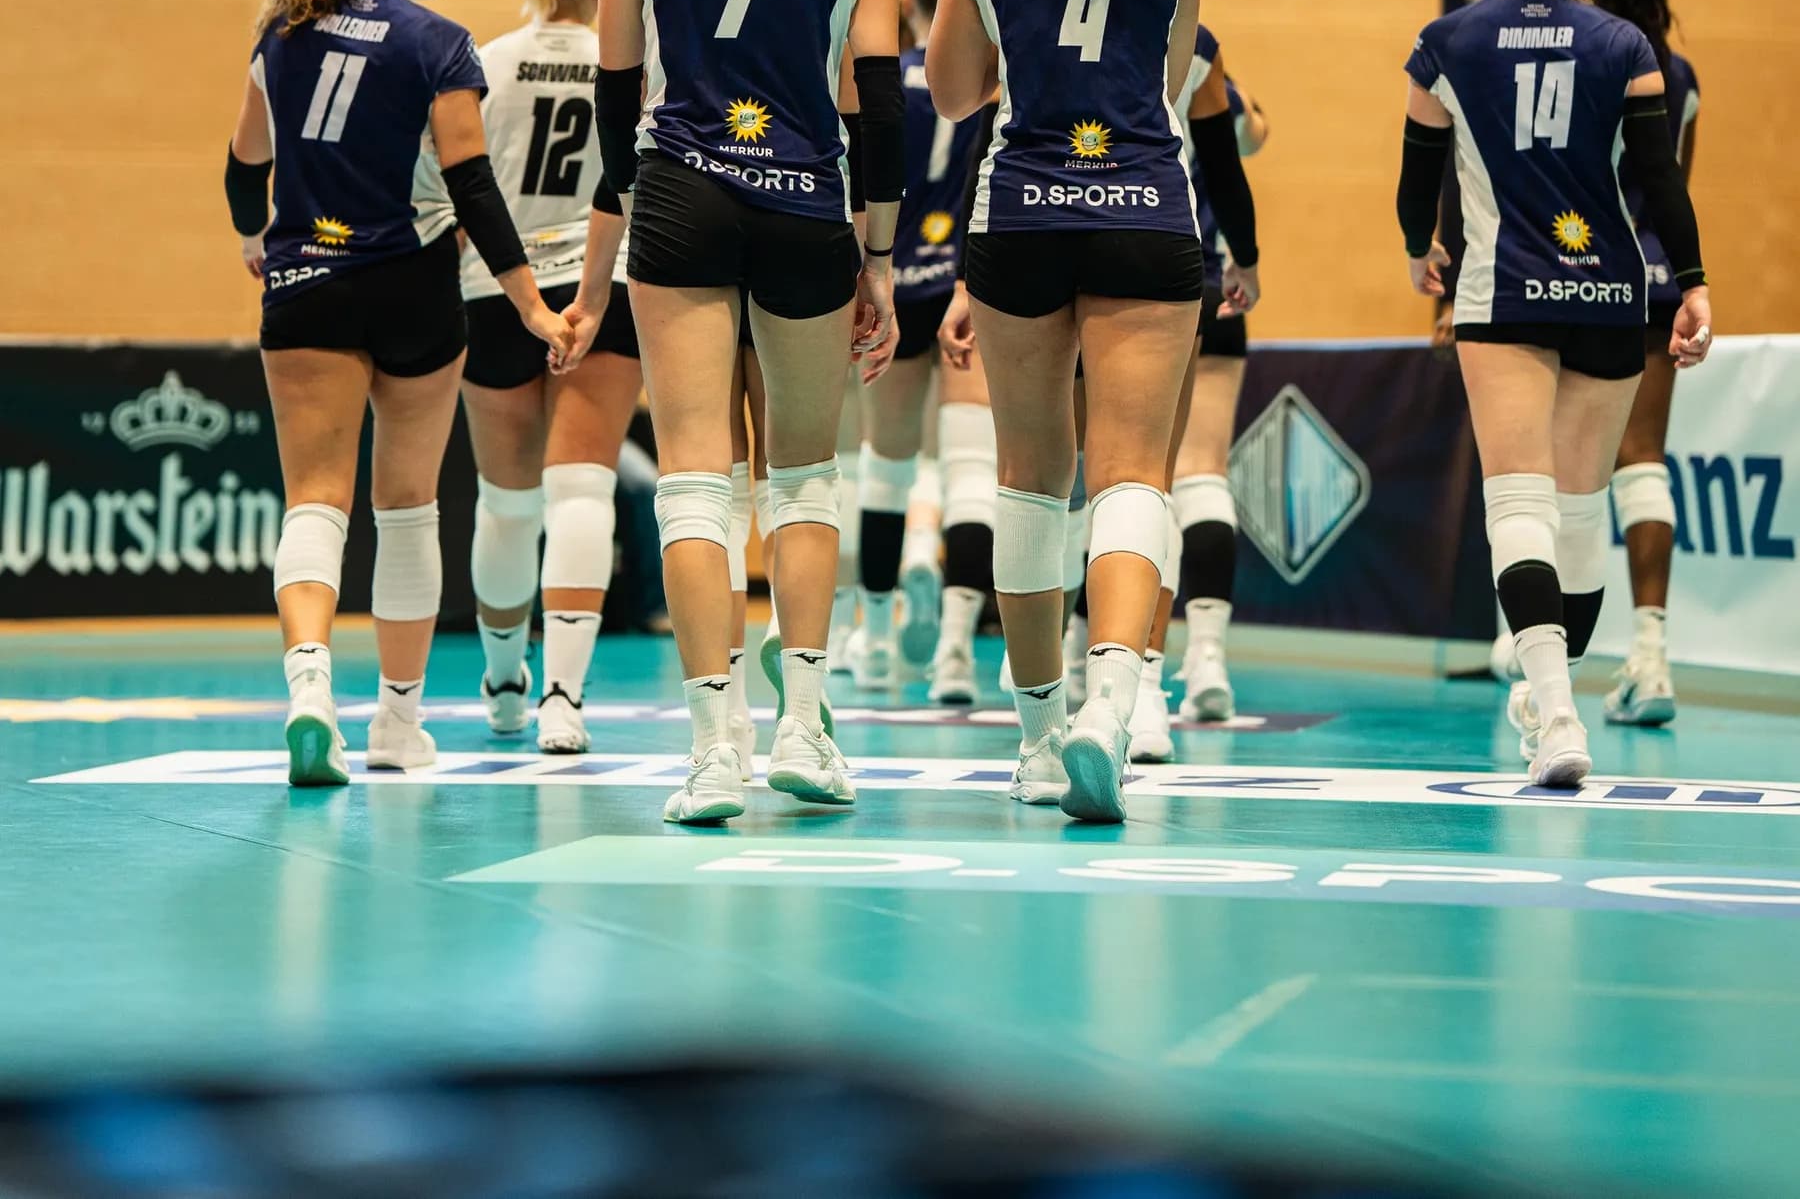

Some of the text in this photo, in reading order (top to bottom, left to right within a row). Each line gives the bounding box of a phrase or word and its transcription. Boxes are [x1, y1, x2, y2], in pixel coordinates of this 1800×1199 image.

[301, 51, 367, 143] 11
[1514, 59, 1576, 151] 14
[520, 96, 593, 197] 12
[719, 145, 774, 157] MERKUR
[1023, 184, 1160, 207] D.SPORTS
[1525, 279, 1632, 304] D.SPORTS
